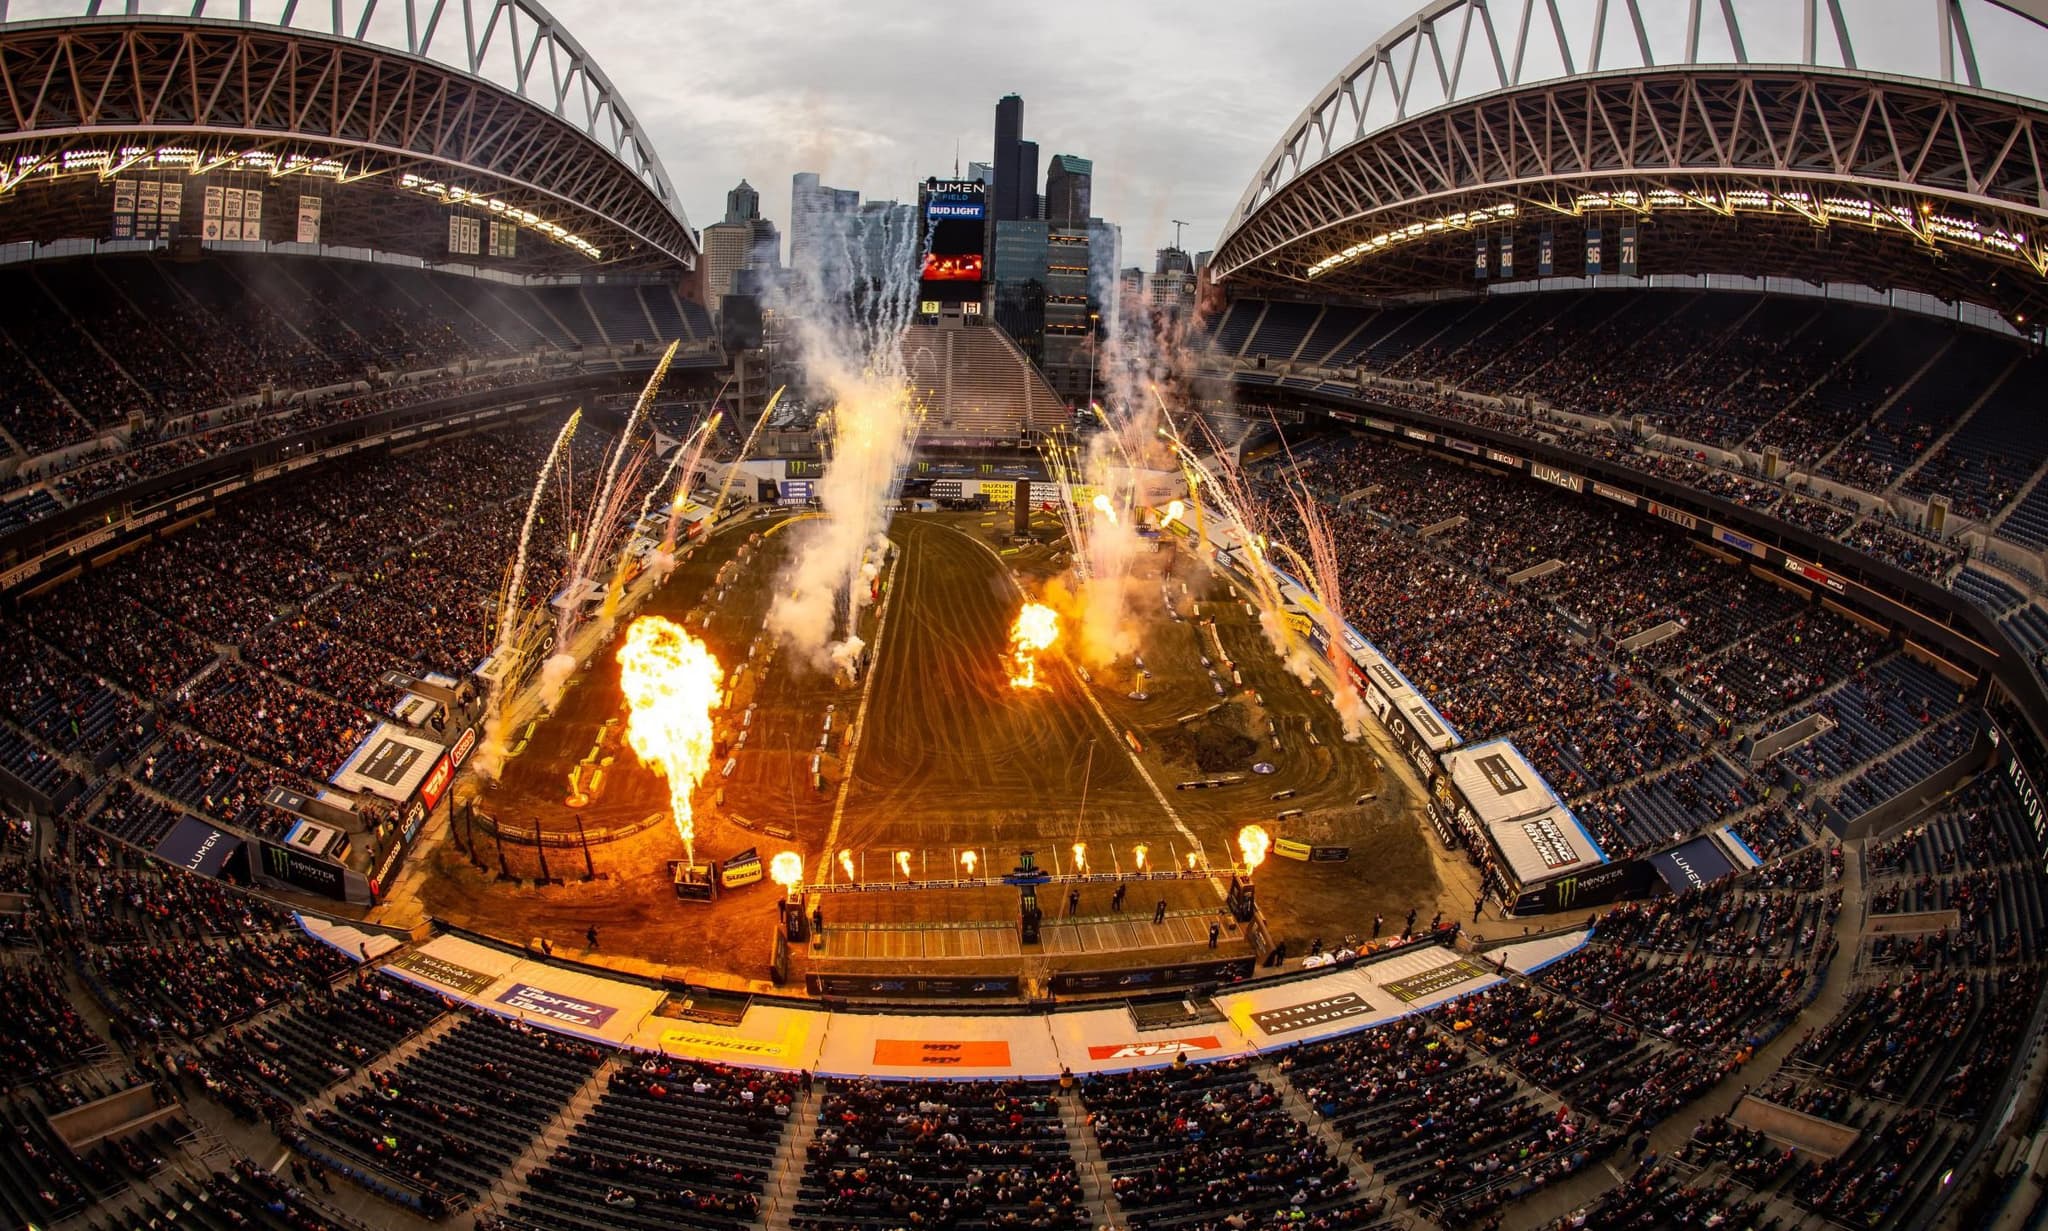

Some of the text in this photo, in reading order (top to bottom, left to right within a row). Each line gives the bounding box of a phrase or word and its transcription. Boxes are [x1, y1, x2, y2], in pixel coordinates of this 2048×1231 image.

[926, 182, 985, 193] LUMEN
[942, 193, 968, 201] FIELD
[930, 206, 980, 215] BUD LIGHT
[1476, 254, 1486, 269] 45
[1502, 252, 1512, 267] 80
[1541, 249, 1551, 265] 12
[1588, 247, 1600, 264] 96
[1622, 246, 1634, 264] 71
[1493, 453, 1514, 465] BECU
[1661, 507, 1692, 529] DELTA
[1785, 558, 1798, 571] 710
[2009, 757, 2047, 842] WELCOME
[401, 802, 422, 834] GoPro
[186, 830, 222, 871] LUMEN
[290, 860, 337, 882] MONSTER
[1577, 868, 1624, 889] MONSTER
[1670, 851, 1703, 889] LUMEN
[409, 964, 461, 989] MONSTER
[422, 957, 474, 980] MONSTER
[1416, 974, 1471, 995] MONSTER
[506, 996, 592, 1026] FALKEN
[517, 990, 602, 1016] FALKEN
[668, 1034, 763, 1053] DUNLOP
[923, 1042, 963, 1052] KTM
[1109, 1043, 1206, 1059] FLY
[921, 1055, 963, 1065] KTM
